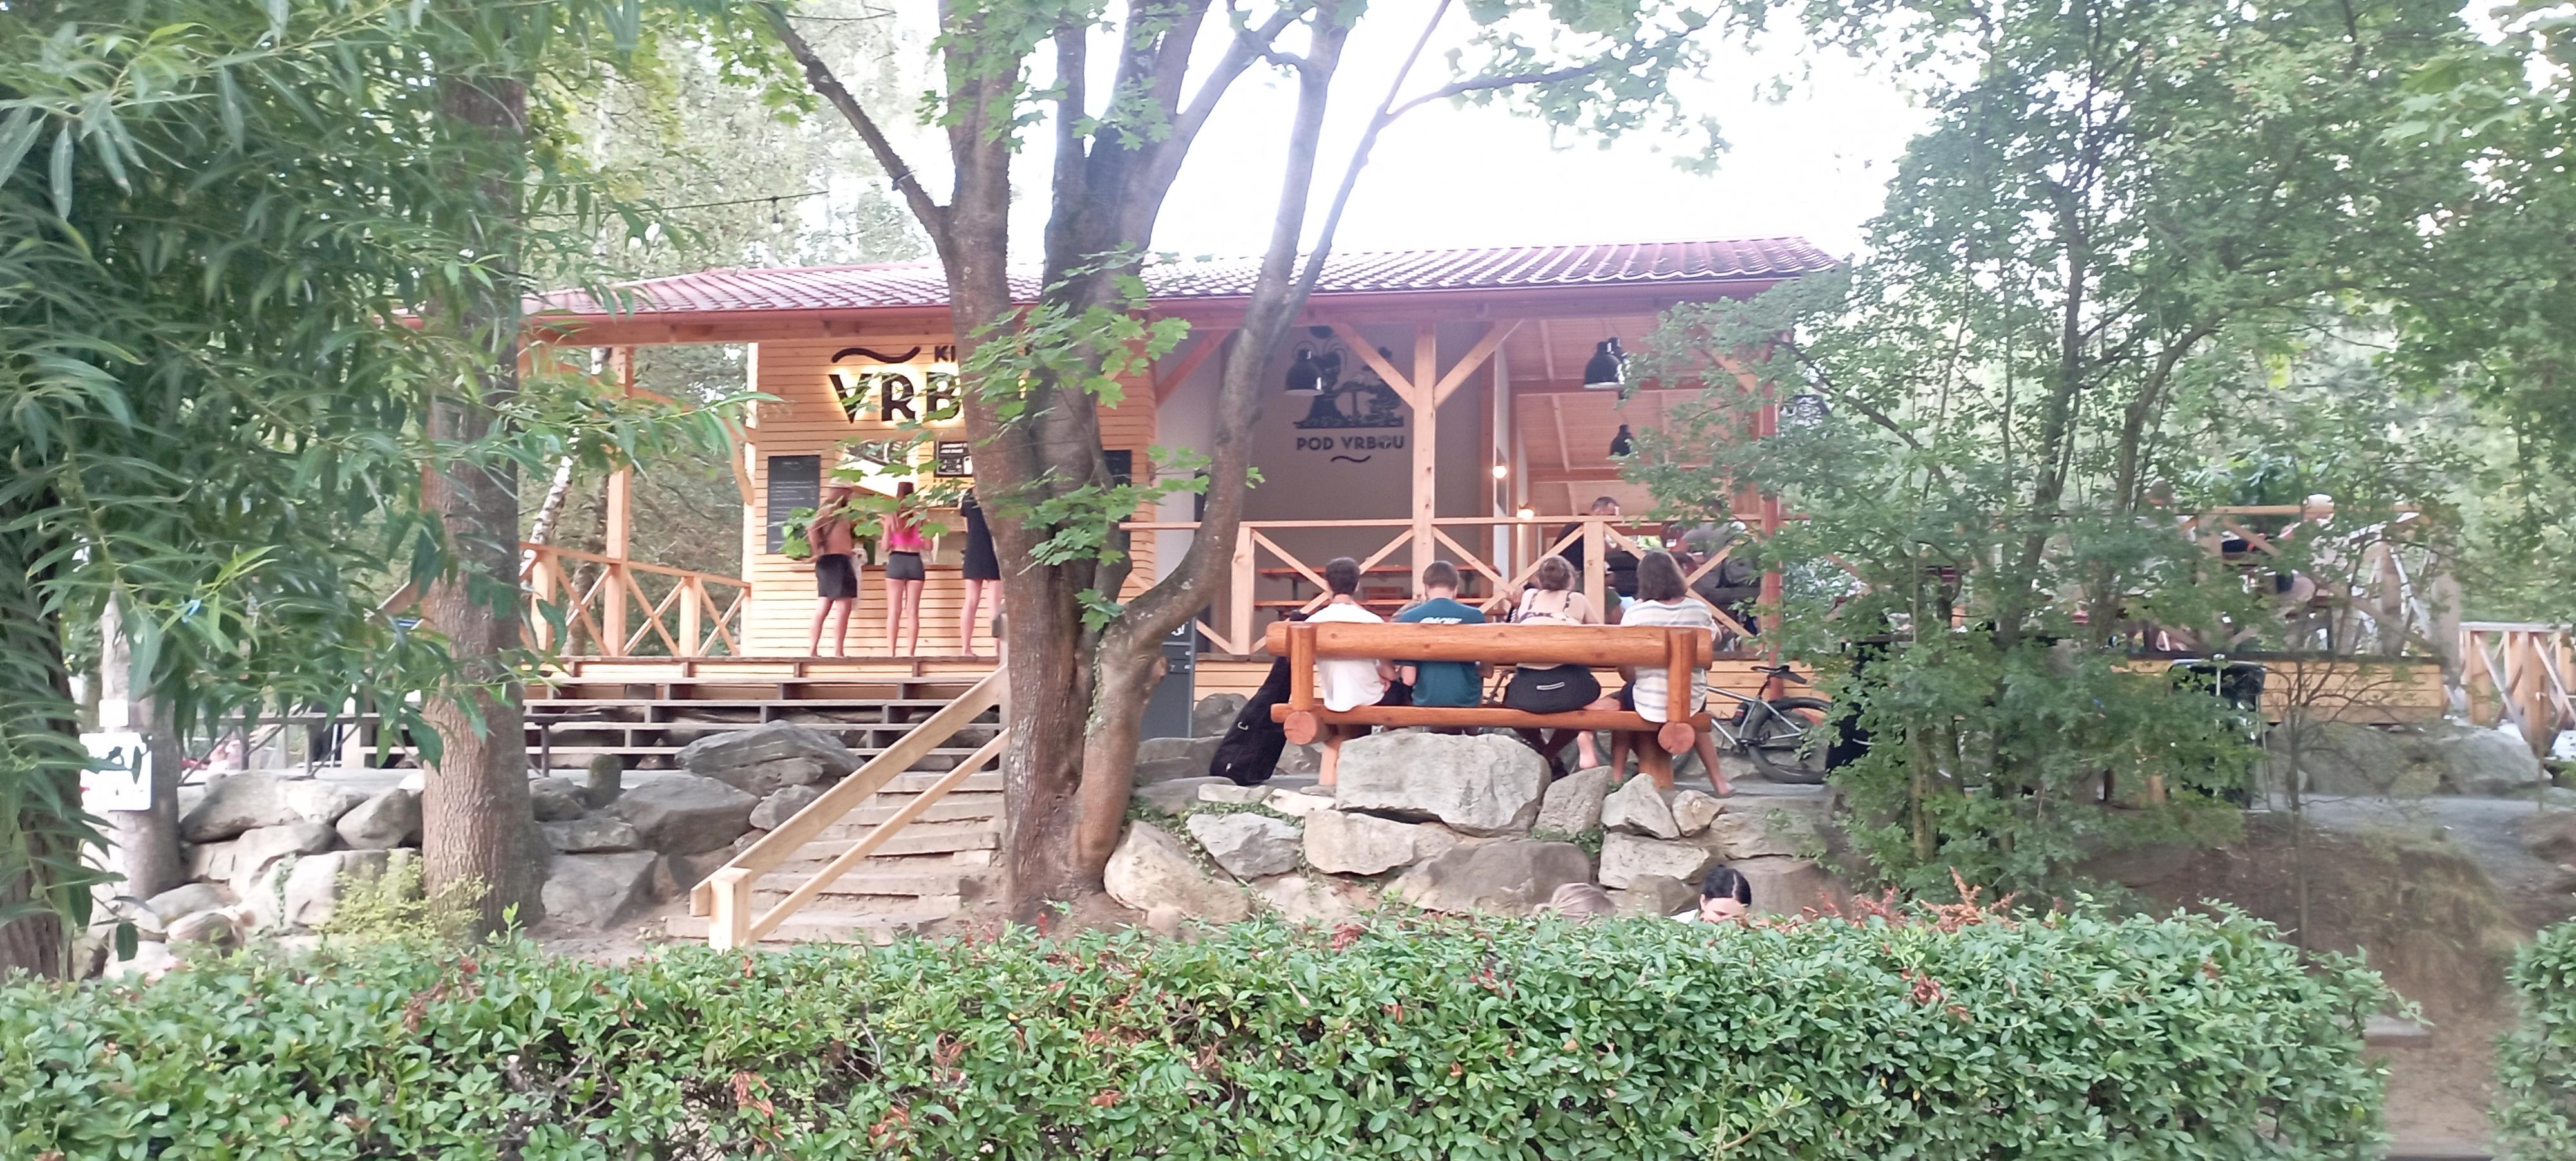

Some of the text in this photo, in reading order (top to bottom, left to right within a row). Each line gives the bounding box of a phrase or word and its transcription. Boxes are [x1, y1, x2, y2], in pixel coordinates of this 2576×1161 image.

[828, 372, 961, 424] VRB
[1296, 435, 1405, 450] POD VRBOU
